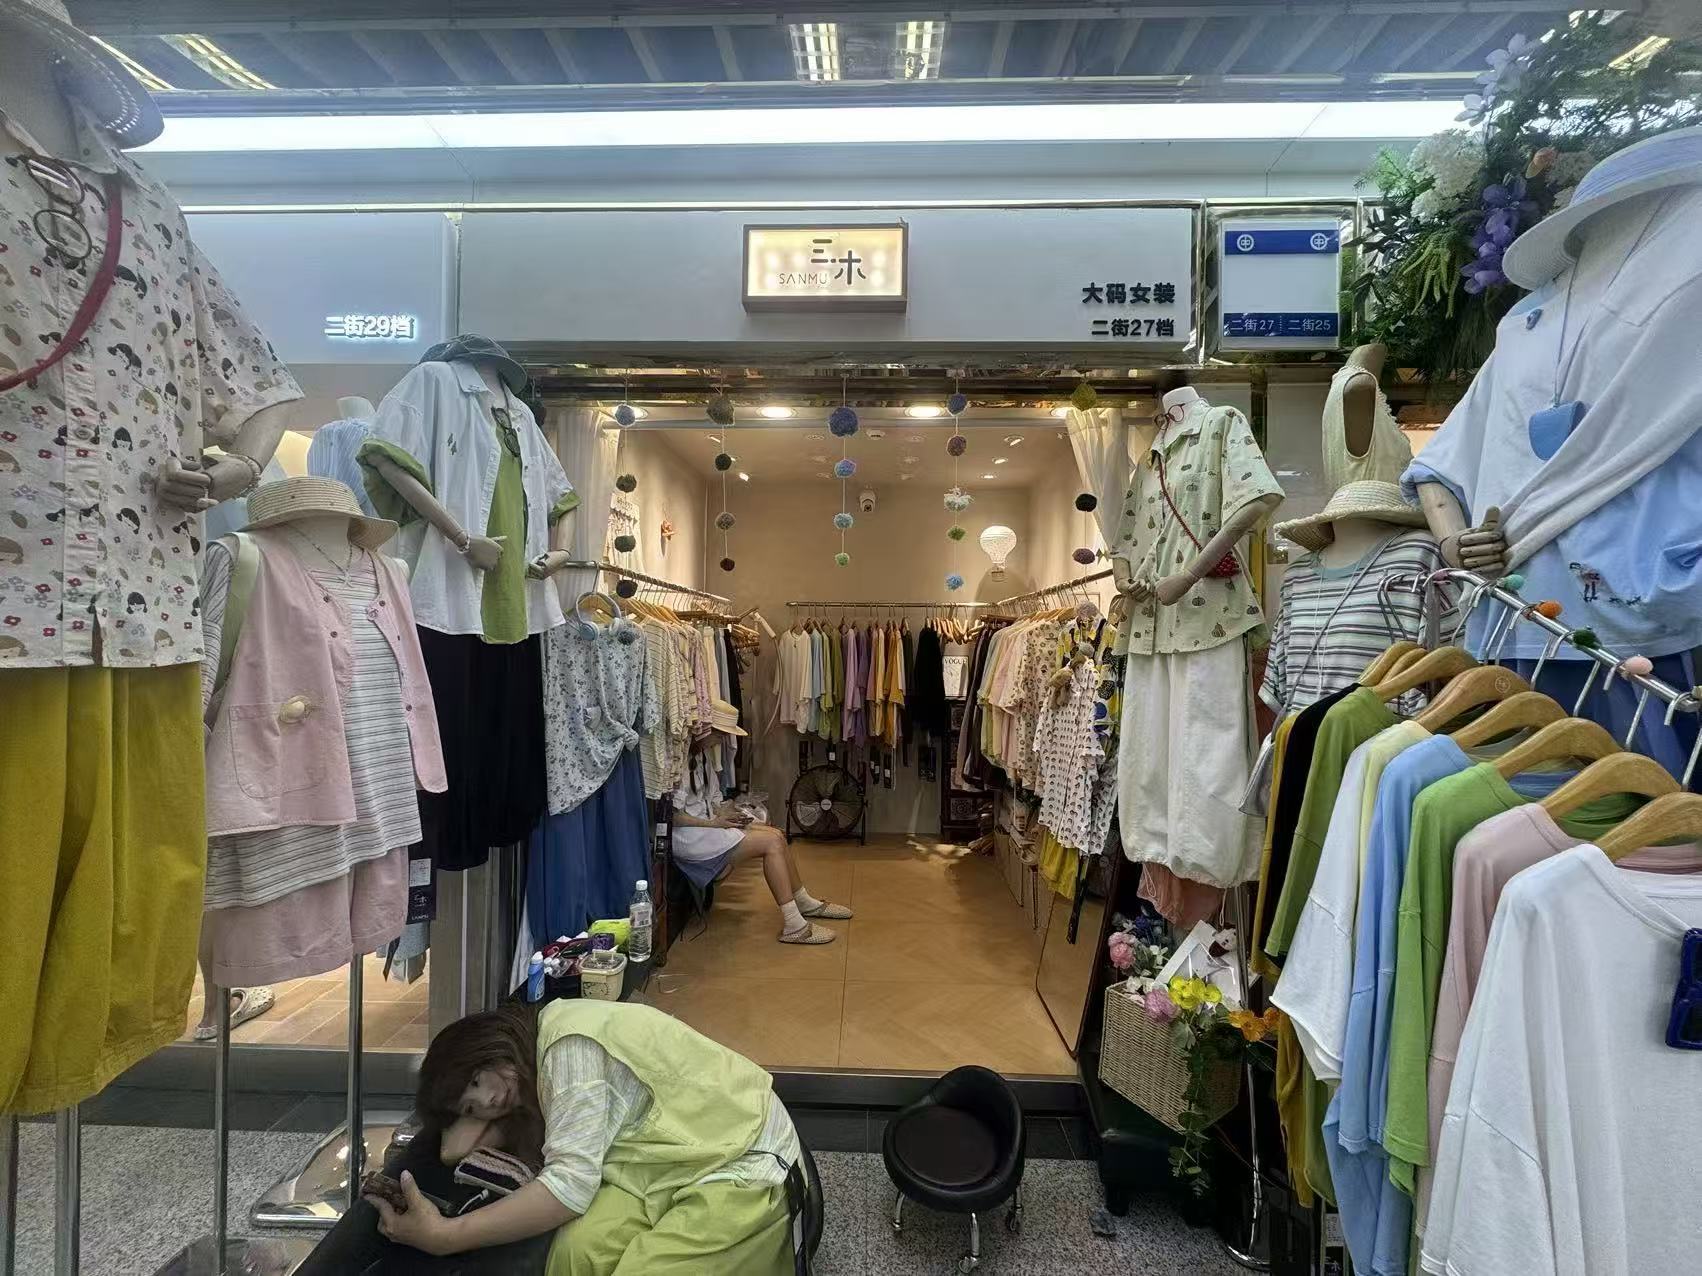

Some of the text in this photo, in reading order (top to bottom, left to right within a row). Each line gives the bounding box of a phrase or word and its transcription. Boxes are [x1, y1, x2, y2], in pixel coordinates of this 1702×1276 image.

[810, 238, 867, 285] 三木
[779, 273, 828, 285] SANMU
[1082, 283, 1176, 304] 大码女装
[324, 315, 414, 338] 二街29档
[1091, 319, 1174, 337] 二街27档
[1230, 318, 1275, 332] 二街27
[1287, 317, 1331, 332] 二街25
